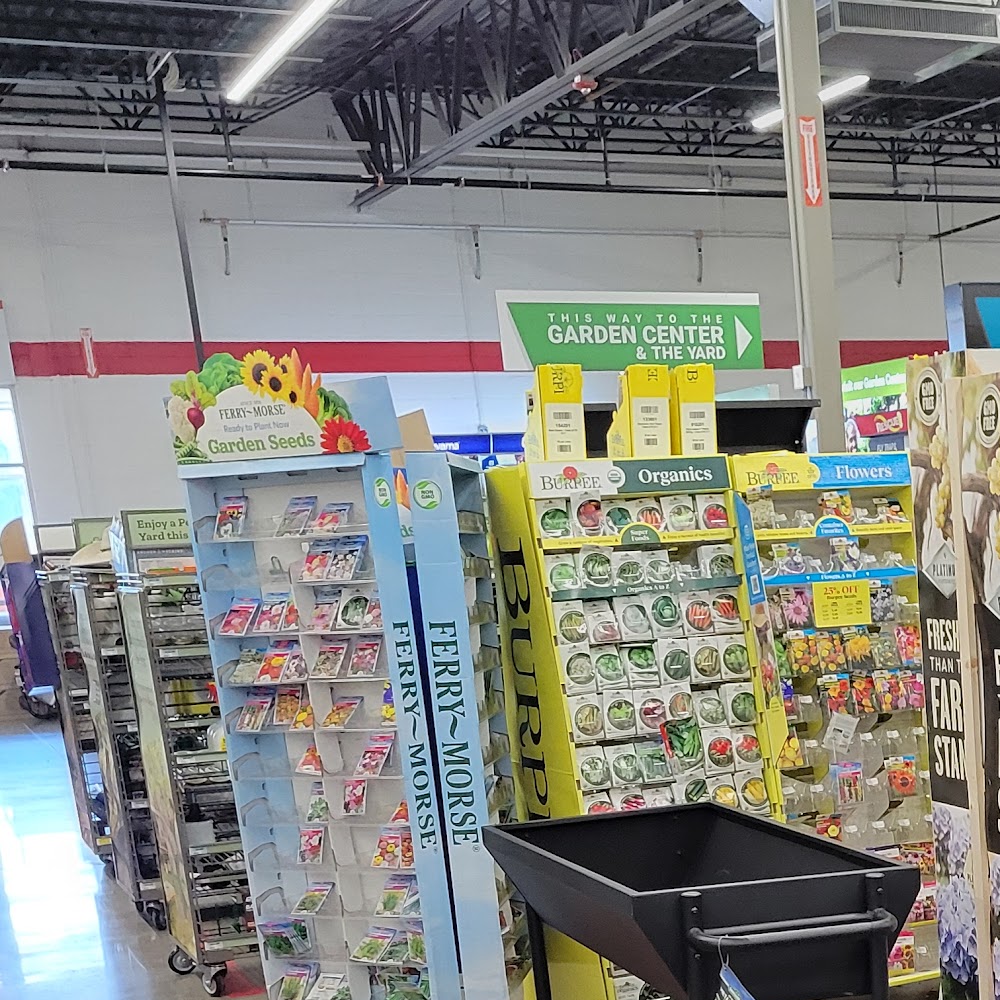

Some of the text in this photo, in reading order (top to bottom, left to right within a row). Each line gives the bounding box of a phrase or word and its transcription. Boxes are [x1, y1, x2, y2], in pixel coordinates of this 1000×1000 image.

[547, 313, 723, 324] THIS WAY TO THE
[547, 325, 724, 344] GARDEN CENTER
[635, 346, 726, 360] & THE YARD
[223, 421, 290, 434] Ready to Plant Now
[208, 433, 316, 454] Garden Seeds
[638, 466, 713, 486] Organics
[745, 472, 800, 485] BURPEE
[836, 464, 893, 480] Flowers
[540, 475, 602, 490] BURPEE
[137, 519, 168, 530] Enjoy
[138, 529, 189, 541] Yard this
[630, 528, 649, 537] Super
[630, 535, 650, 543] Foods
[932, 564, 957, 578] PLATINU
[627, 585, 651, 593] Organics
[926, 617, 960, 652] FRESH
[929, 655, 954, 672] THAN
[498, 537, 551, 821] BURP
[930, 677, 964, 733] FAR
[934, 735, 966, 780] STAN
